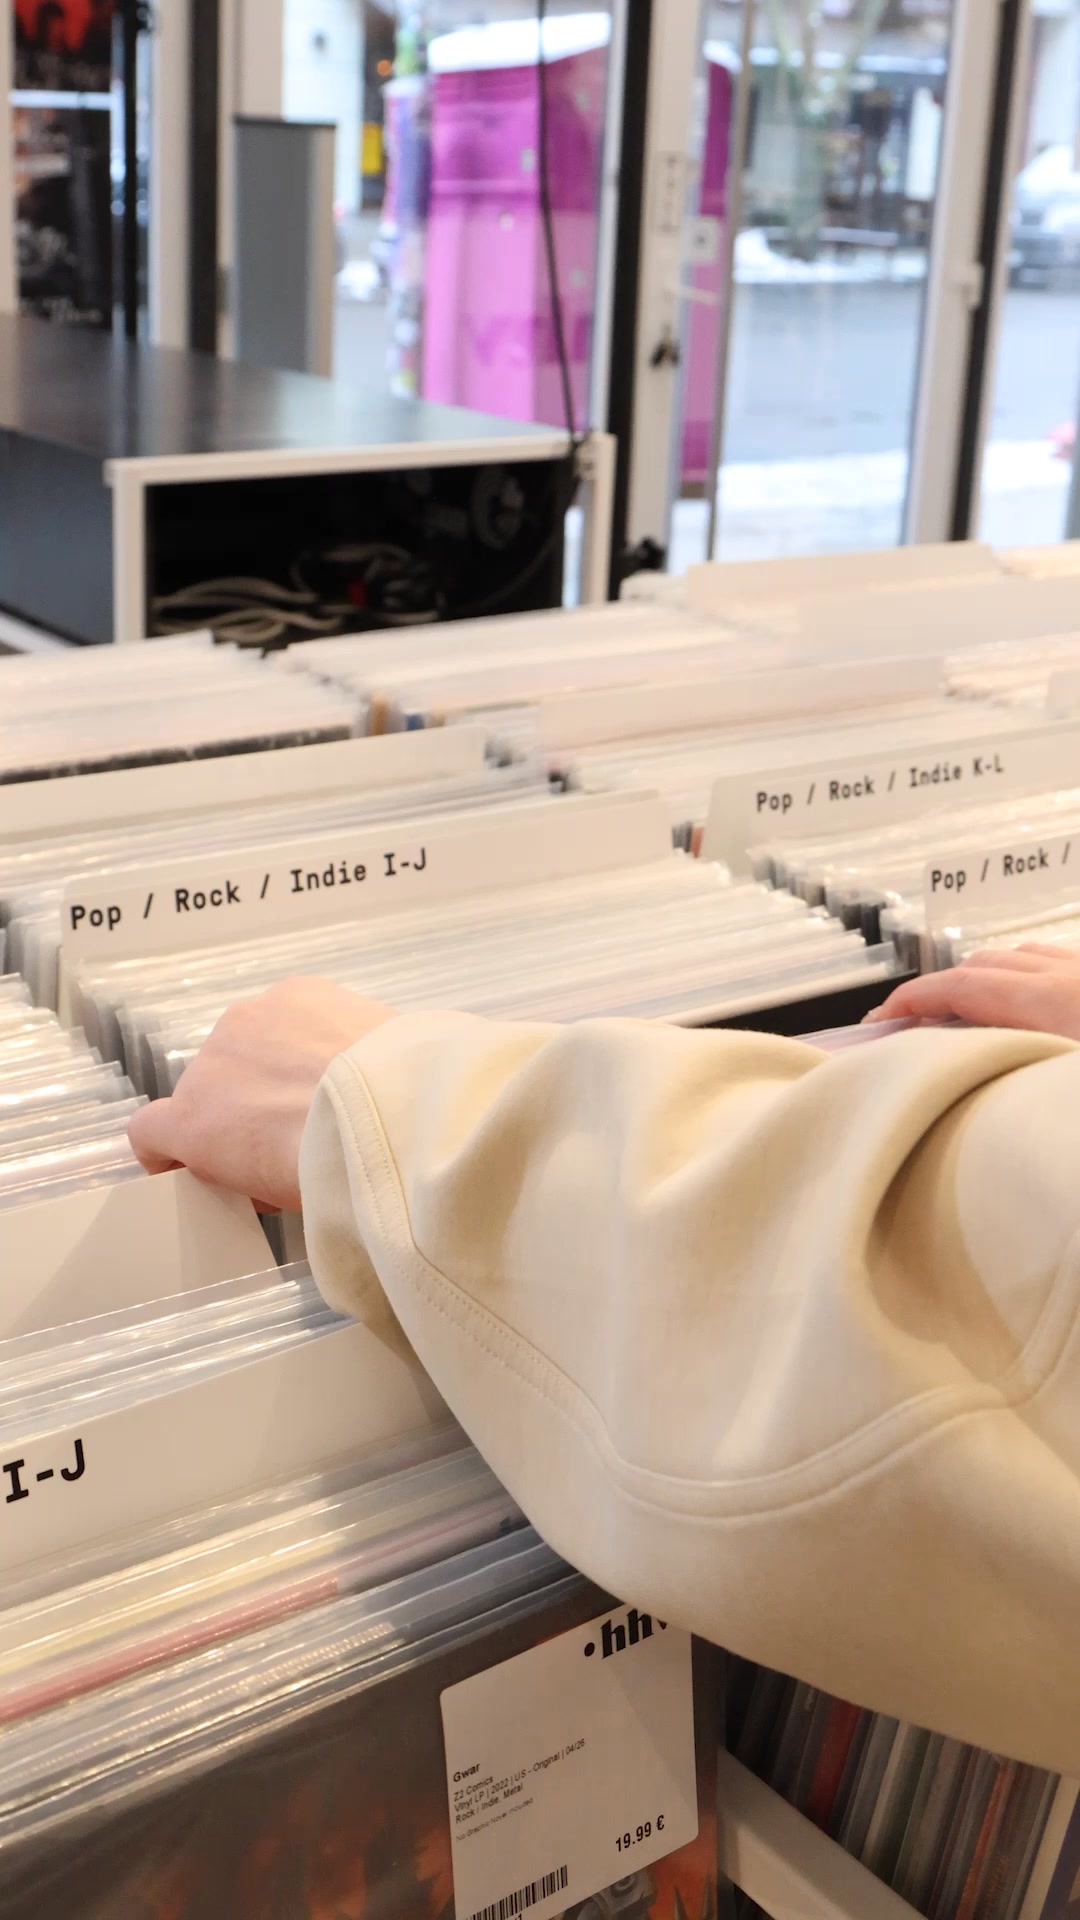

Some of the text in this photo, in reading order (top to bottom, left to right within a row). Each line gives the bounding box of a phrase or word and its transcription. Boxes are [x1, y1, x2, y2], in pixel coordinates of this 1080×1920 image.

[756, 755, 1004, 814] Pop / Rock / Indie K-L
[70, 847, 427, 931] Pop / Rock / Indie I-J
[931, 842, 1071, 892] Pop / Rock /
[2, 1438, 86, 1504] I-J
[453, 1763, 481, 1783] Gwar
[454, 1797, 473, 1813] Vinyl
[474, 1790, 485, 1803] LP
[491, 1777, 509, 1795] 2022
[514, 1768, 527, 1782] US
[533, 1751, 560, 1773] Original
[565, 1738, 586, 1756] 04/26
[454, 1776, 494, 1802] Z2 Comics
[455, 1808, 476, 1825] Rock
[503, 1782, 523, 1800] Metal
[615, 1814, 665, 1852] 19.99 €
